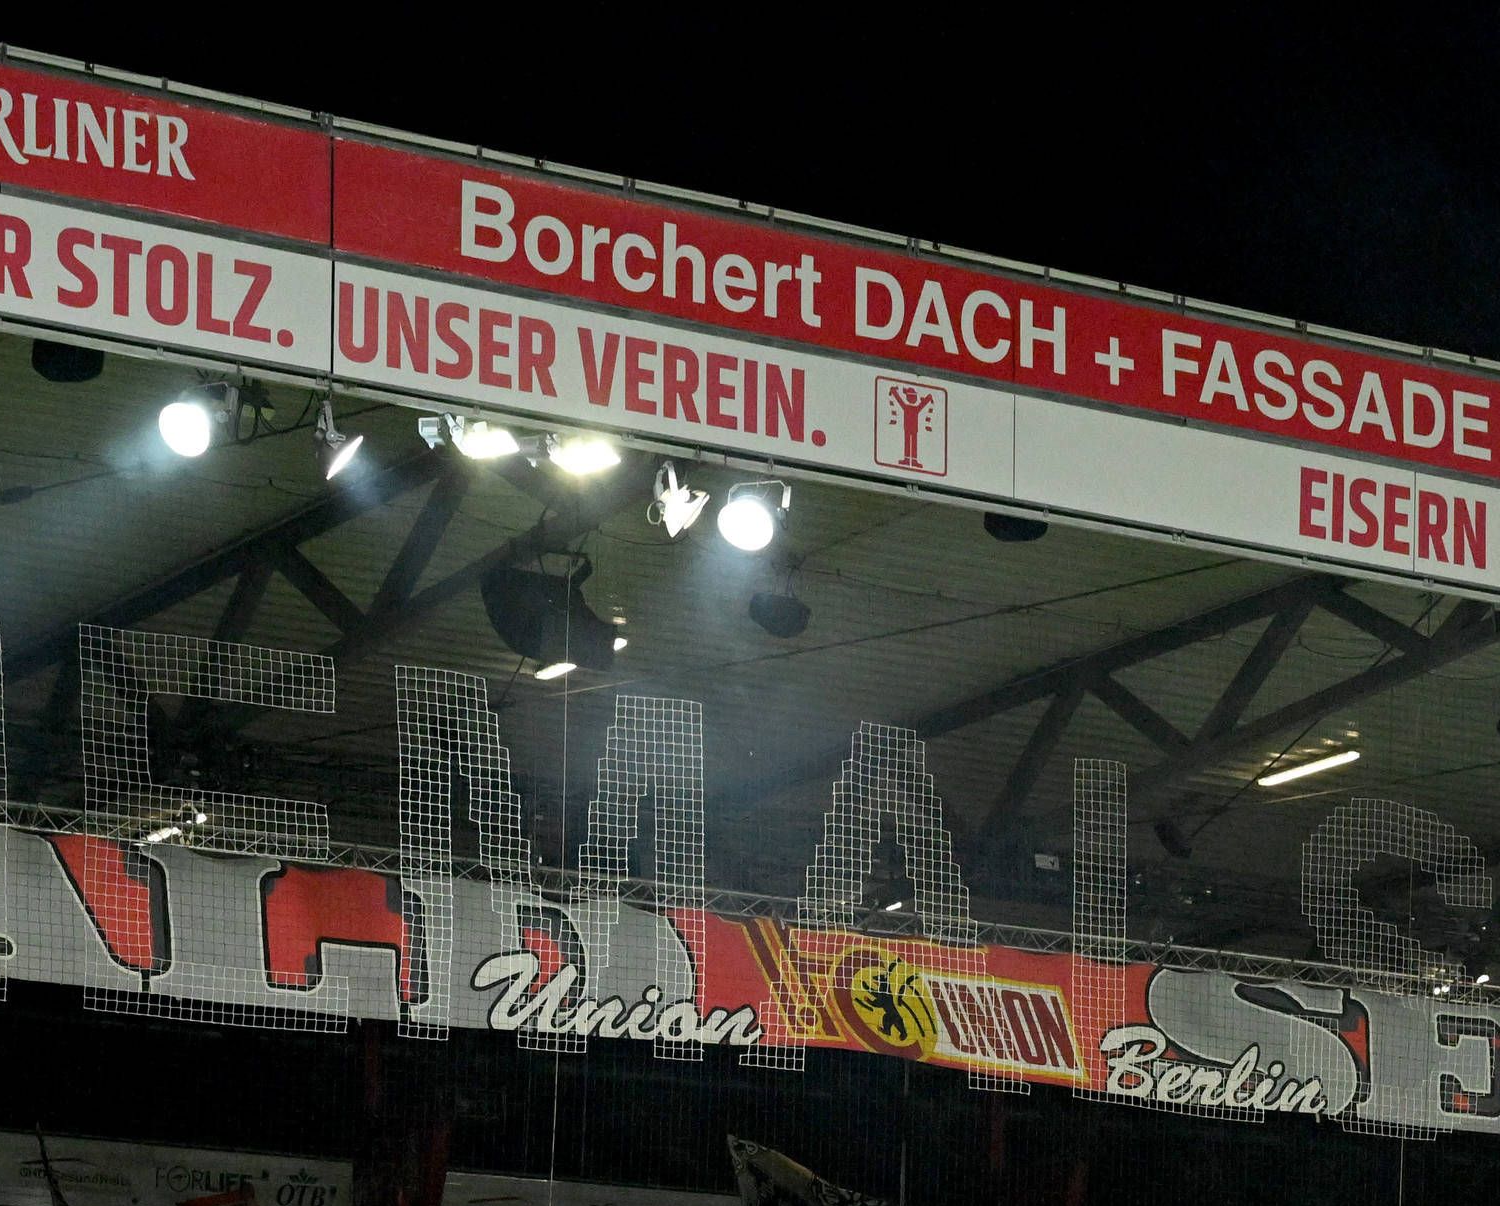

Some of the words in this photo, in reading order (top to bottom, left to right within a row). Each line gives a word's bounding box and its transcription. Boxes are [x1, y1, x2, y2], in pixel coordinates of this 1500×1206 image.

[56, 226, 294, 348] STOLZ.
[460, 178, 821, 328] Borchert
[854, 265, 1067, 375] DACH
[1094, 336, 1135, 387] +
[1161, 327, 1492, 462] FASSADE
[337, 281, 556, 398] UNSER
[577, 326, 827, 448] VEREIN.
[1299, 466, 1487, 570] EISERN
[471, 951, 762, 1046] Union
[1101, 1024, 1328, 1117] Berlin
